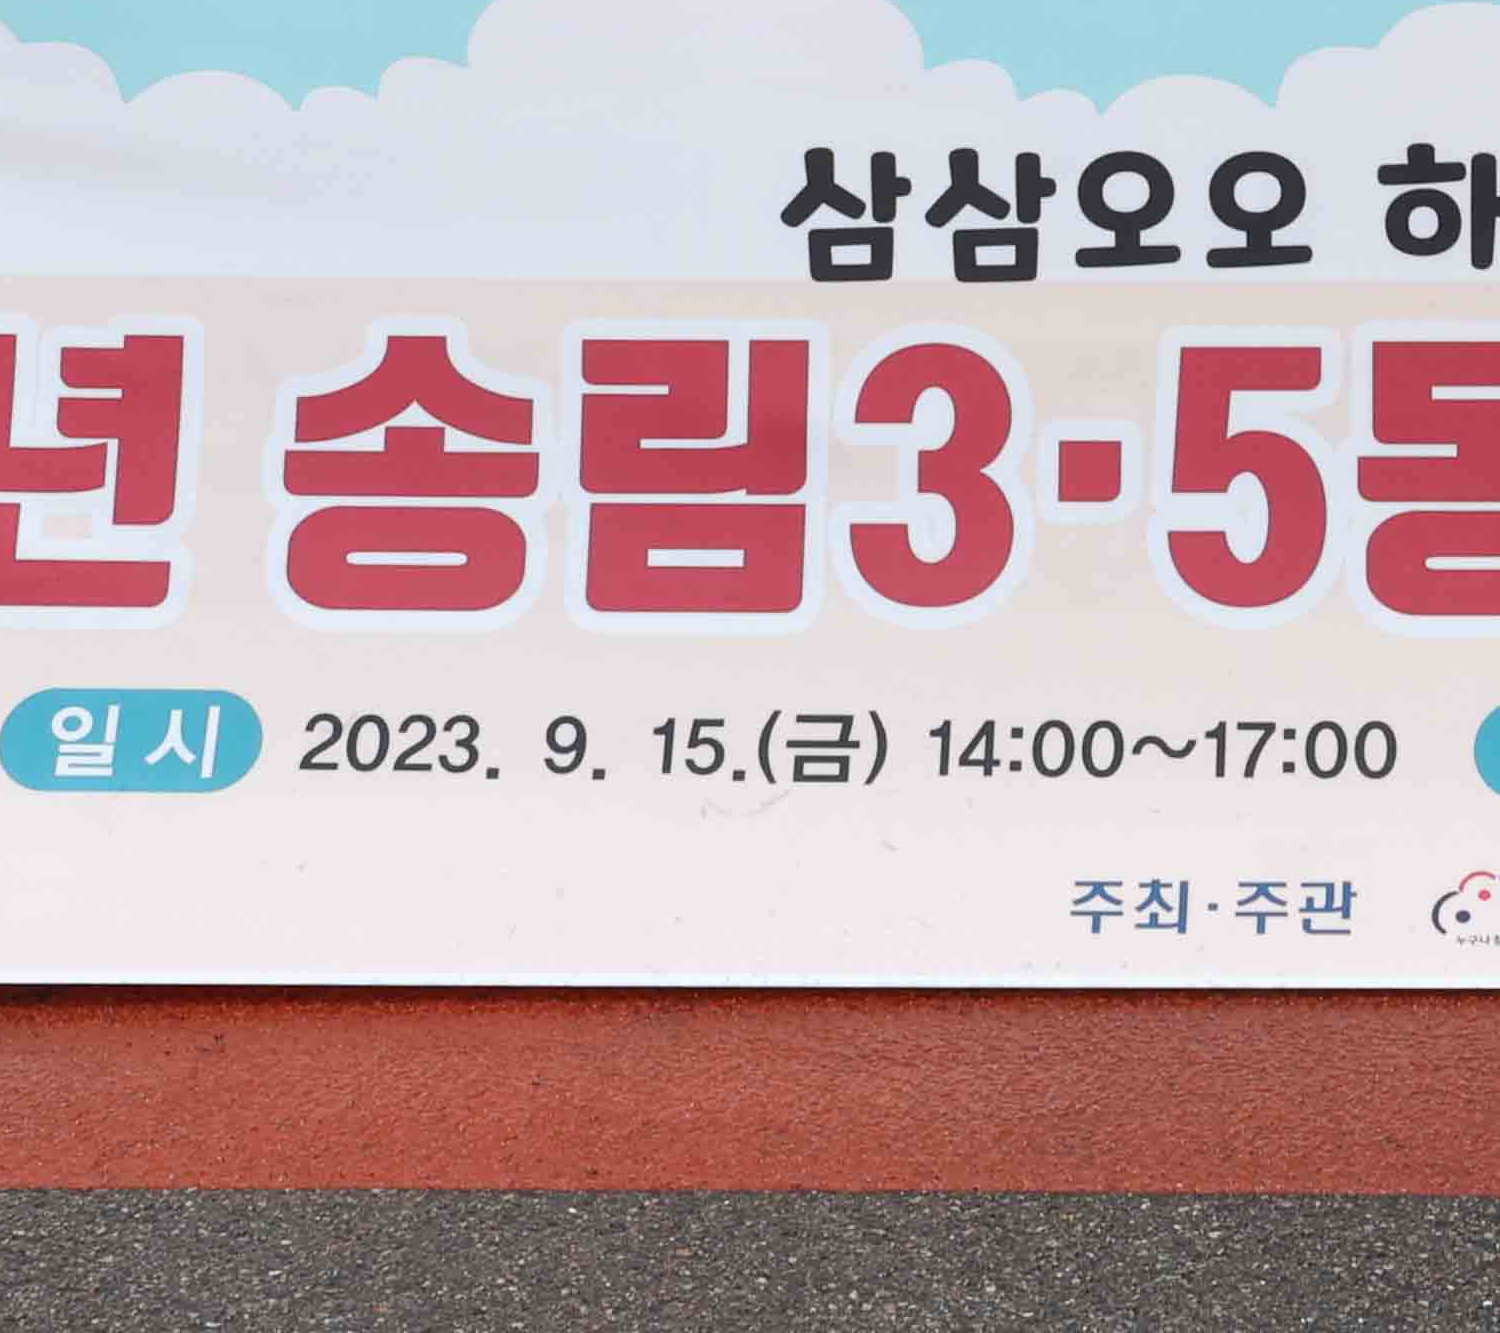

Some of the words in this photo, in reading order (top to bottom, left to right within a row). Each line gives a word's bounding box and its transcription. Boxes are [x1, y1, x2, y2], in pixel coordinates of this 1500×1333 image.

[780, 146, 1313, 284] 삼삼오오
[299, 713, 499, 780] 2023.
[544, 715, 606, 780] 9.
[653, 710, 888, 785] 15.(금)
[929, 719, 1397, 779] 14:00~17:00
[1068, 878, 1357, 936] 주최·주관
[1456, 934, 1490, 946] 누구나
